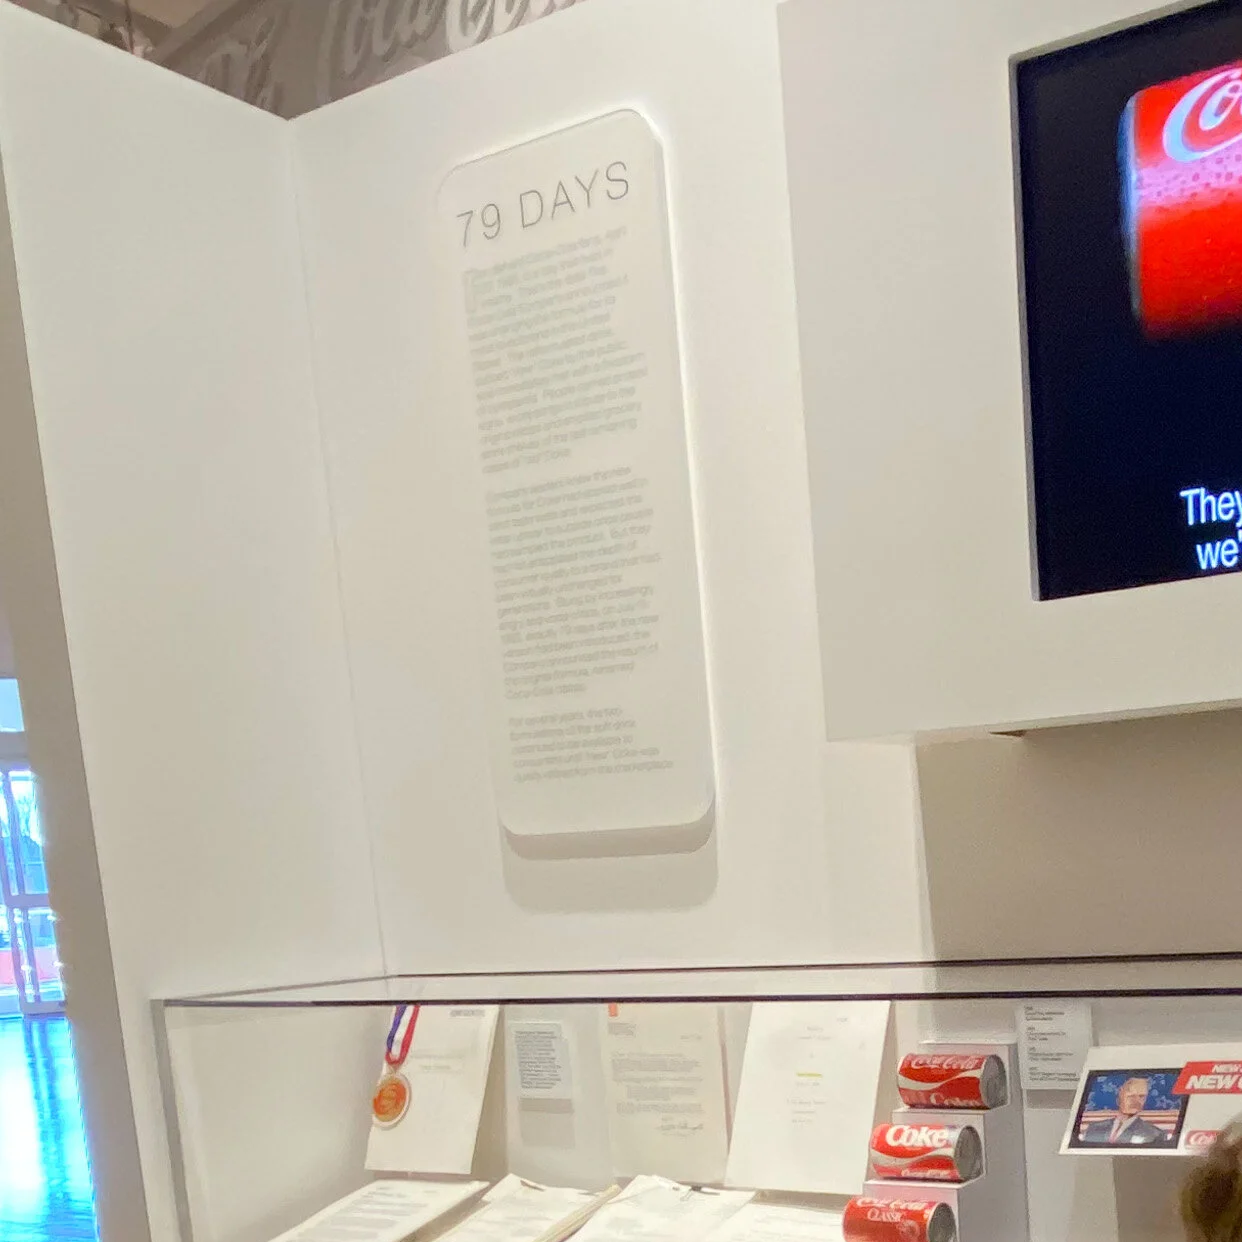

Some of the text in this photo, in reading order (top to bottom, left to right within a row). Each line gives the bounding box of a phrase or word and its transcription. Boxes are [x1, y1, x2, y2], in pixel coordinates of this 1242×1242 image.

[455, 160, 630, 248] 79 DAYS
[1185, 1074, 1242, 1091] NEW
[885, 1124, 950, 1148] Coke
